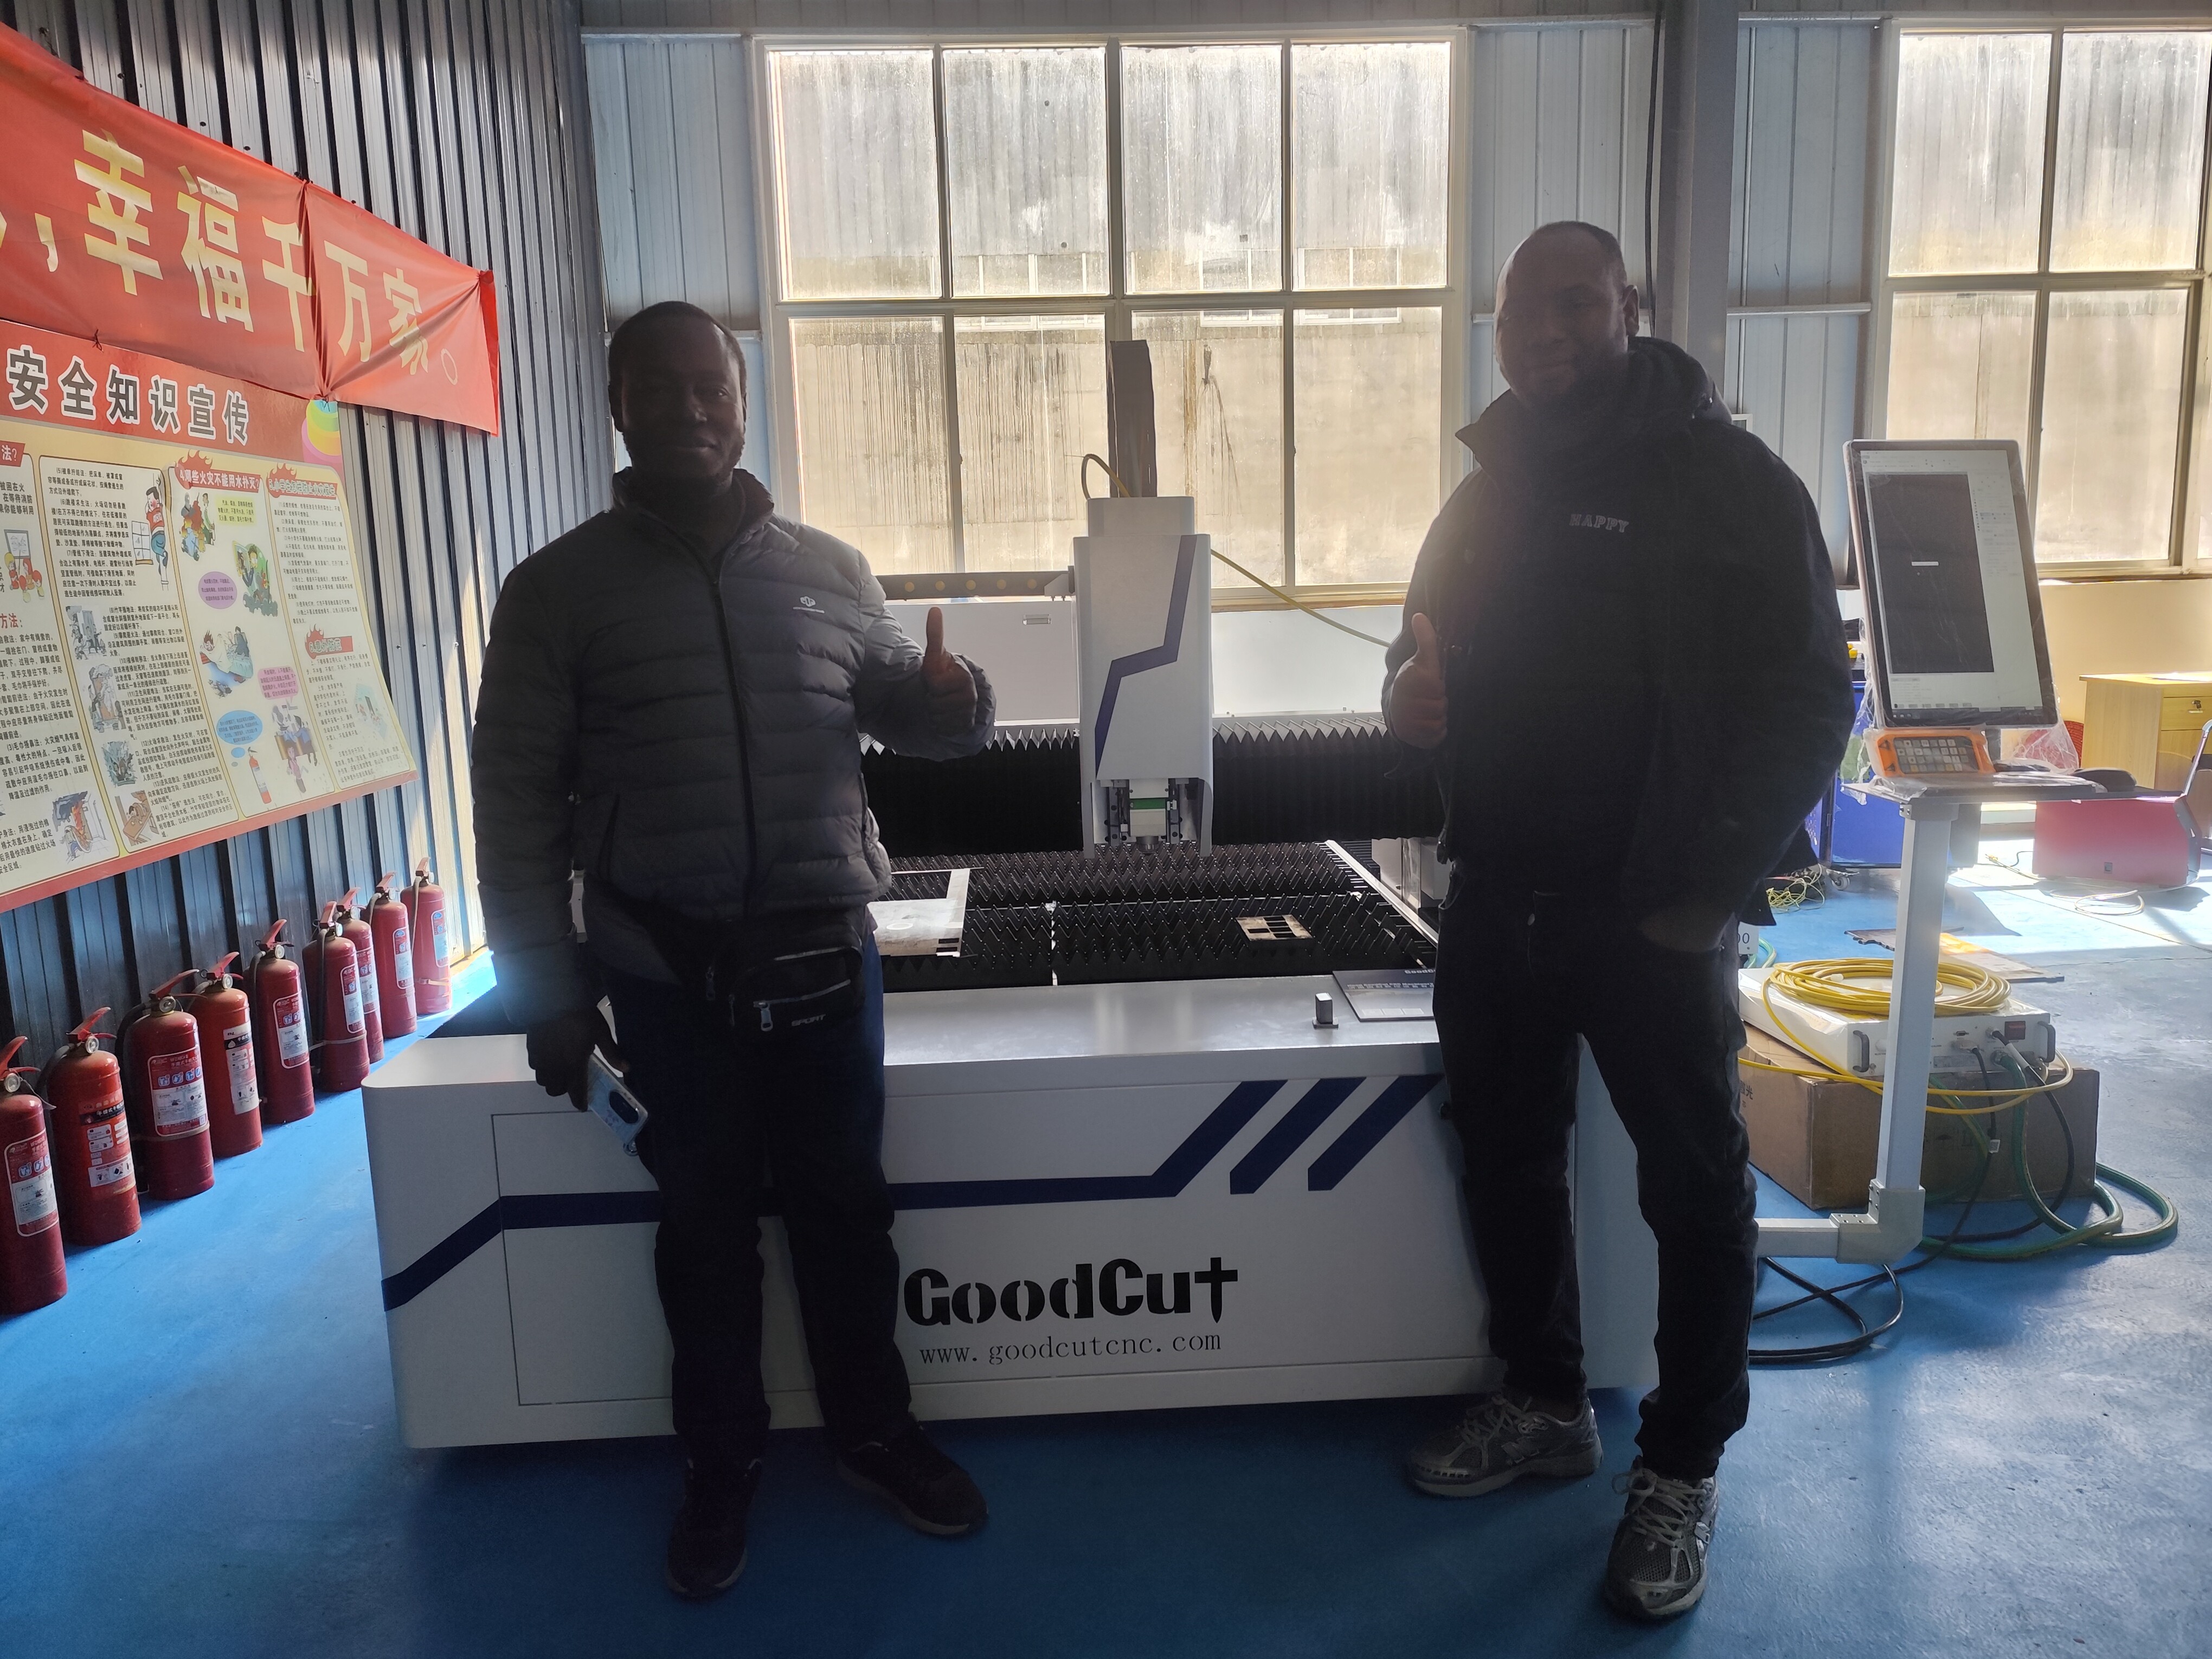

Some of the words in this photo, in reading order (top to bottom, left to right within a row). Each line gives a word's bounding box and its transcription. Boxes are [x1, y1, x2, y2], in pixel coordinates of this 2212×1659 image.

[0, 128, 459, 386] ，幸福千万家。
[6, 344, 249, 446] 安全知识宣传
[179, 469, 259, 490] 4.哪些火灾不能用水扑灭?
[2, 492, 33, 504] 在等待消防
[1569, 513, 1629, 532] HAPPY
[0, 678, 50, 692] 套、毛巾将手保护好。
[904, 1257, 1238, 1326] GoodCut
